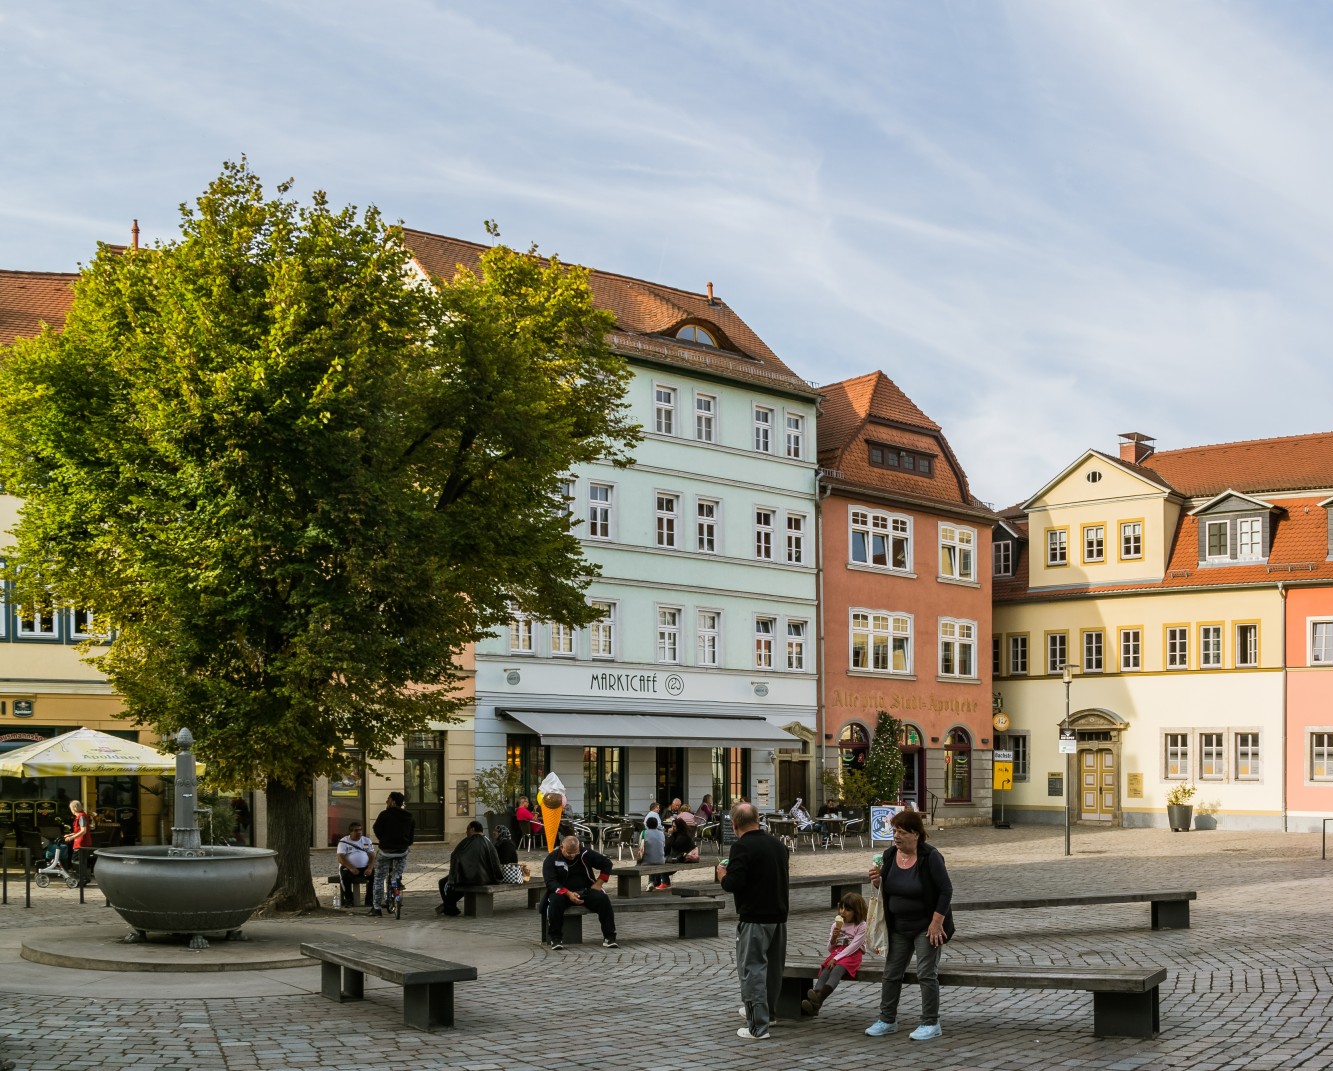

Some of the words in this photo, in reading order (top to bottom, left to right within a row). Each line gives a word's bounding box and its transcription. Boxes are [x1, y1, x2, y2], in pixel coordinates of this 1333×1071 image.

[590, 673, 658, 693] MARKTCAFÉ
[832, 689, 858, 708] Alte
[72, 764, 91, 773] Das
[94, 764, 115, 773] Bier
